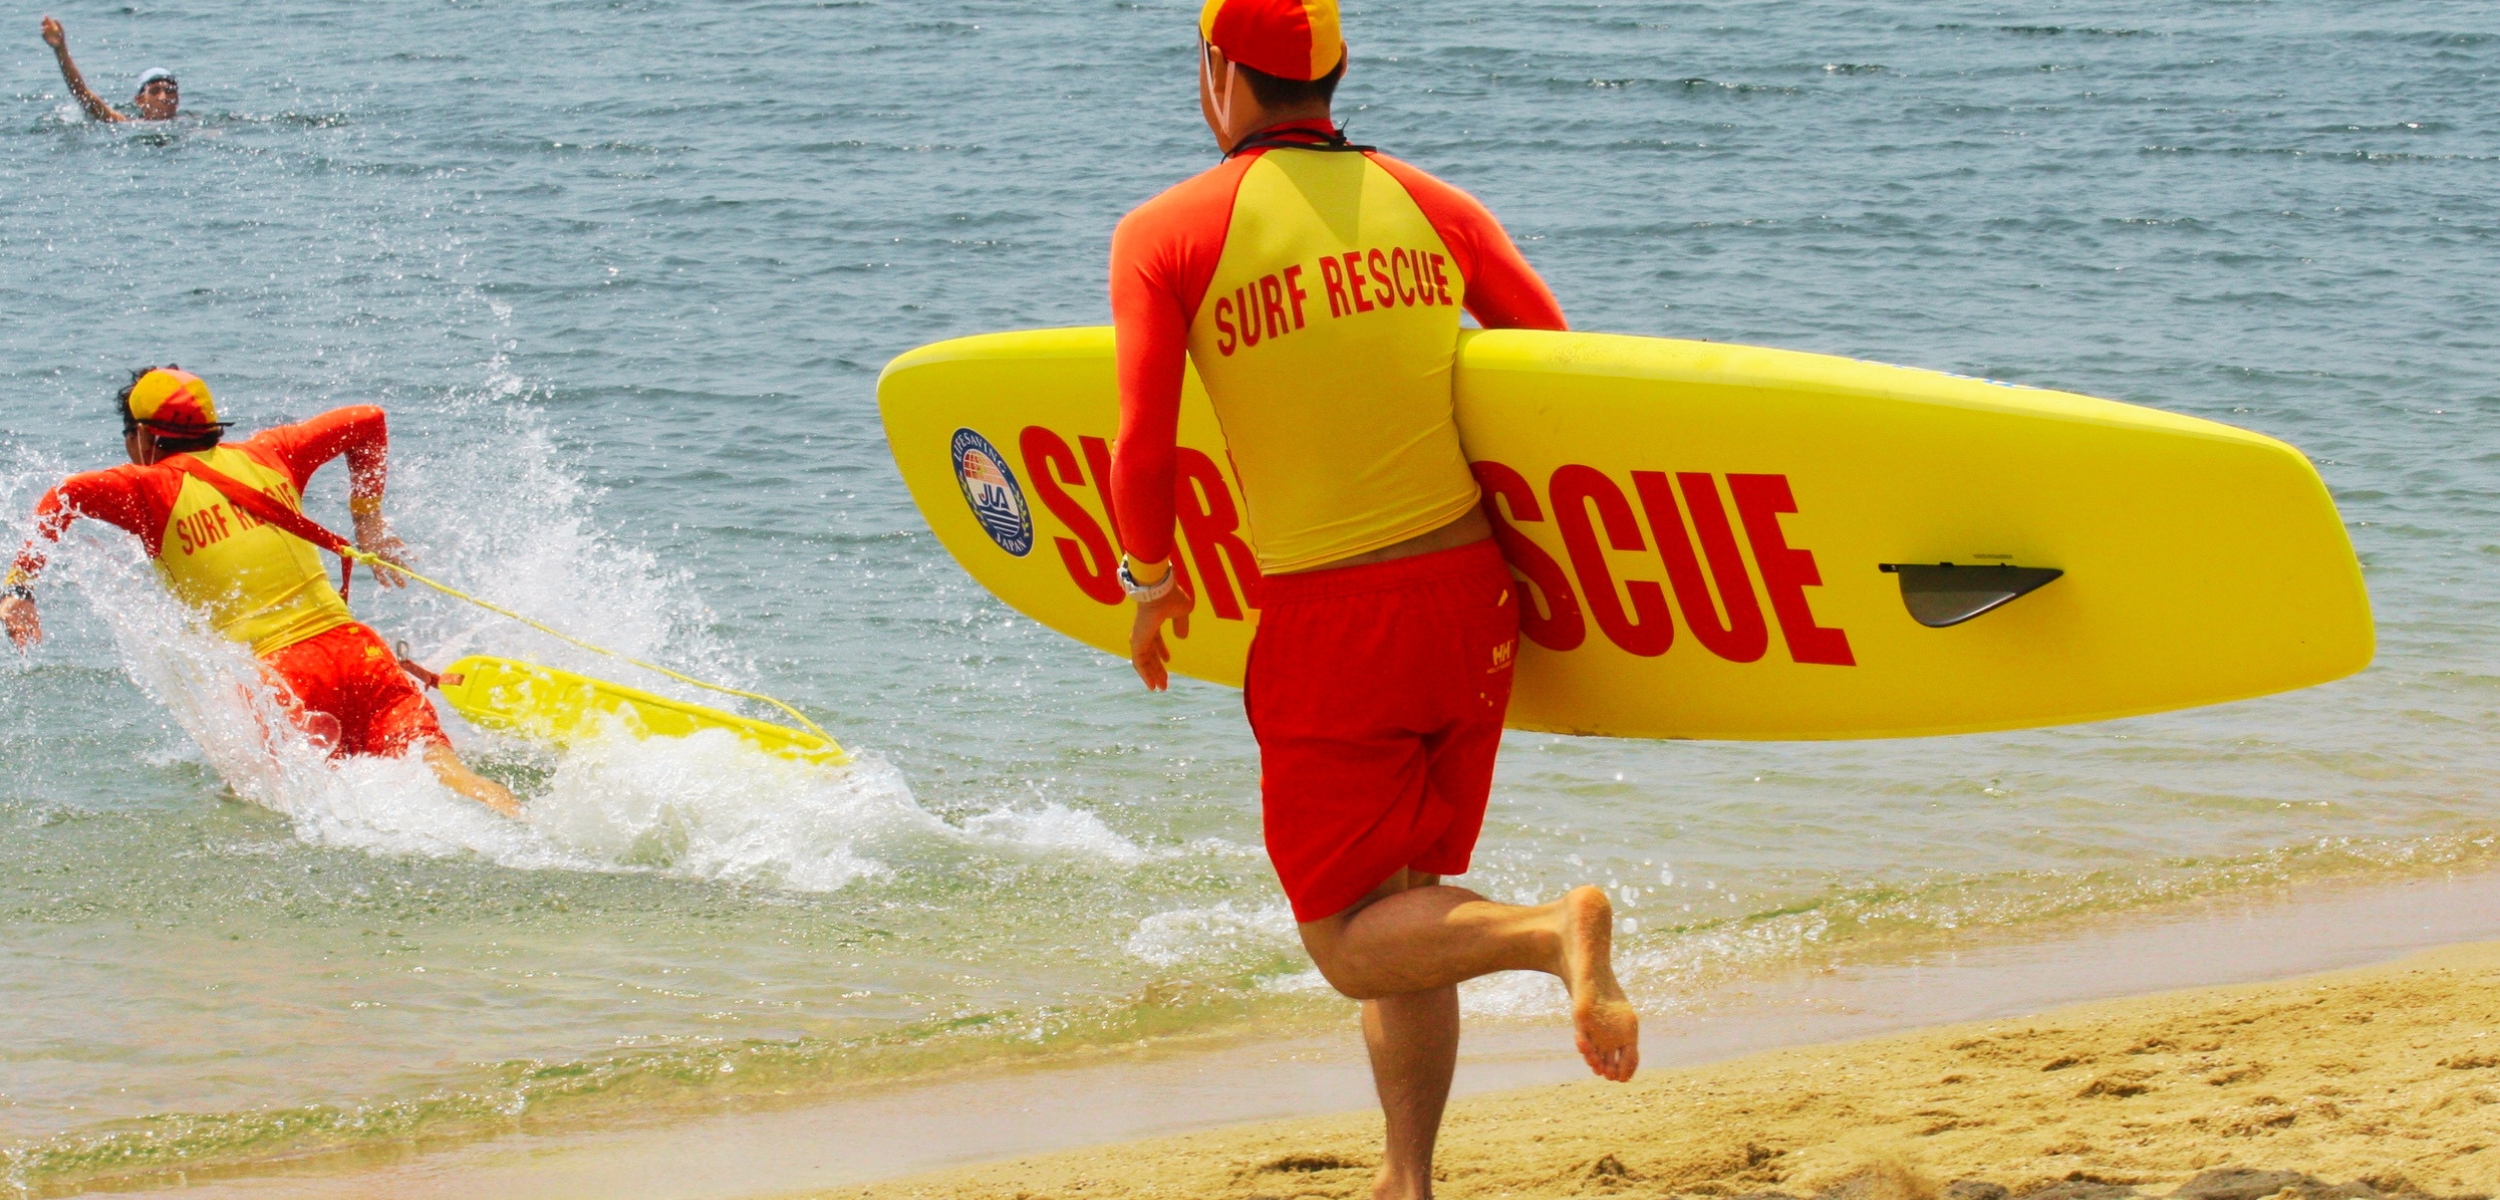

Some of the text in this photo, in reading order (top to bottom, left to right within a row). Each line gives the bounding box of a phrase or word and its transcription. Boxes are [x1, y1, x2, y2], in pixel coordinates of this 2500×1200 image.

[1214, 246, 1453, 357] SURF RESCUE
[953, 432, 1007, 474] LIFESAVING
[978, 483, 1011, 512] JLA
[176, 503, 230, 556] SURF
[995, 532, 1028, 553] JAPAN
[1470, 460, 1857, 667] SCUE
